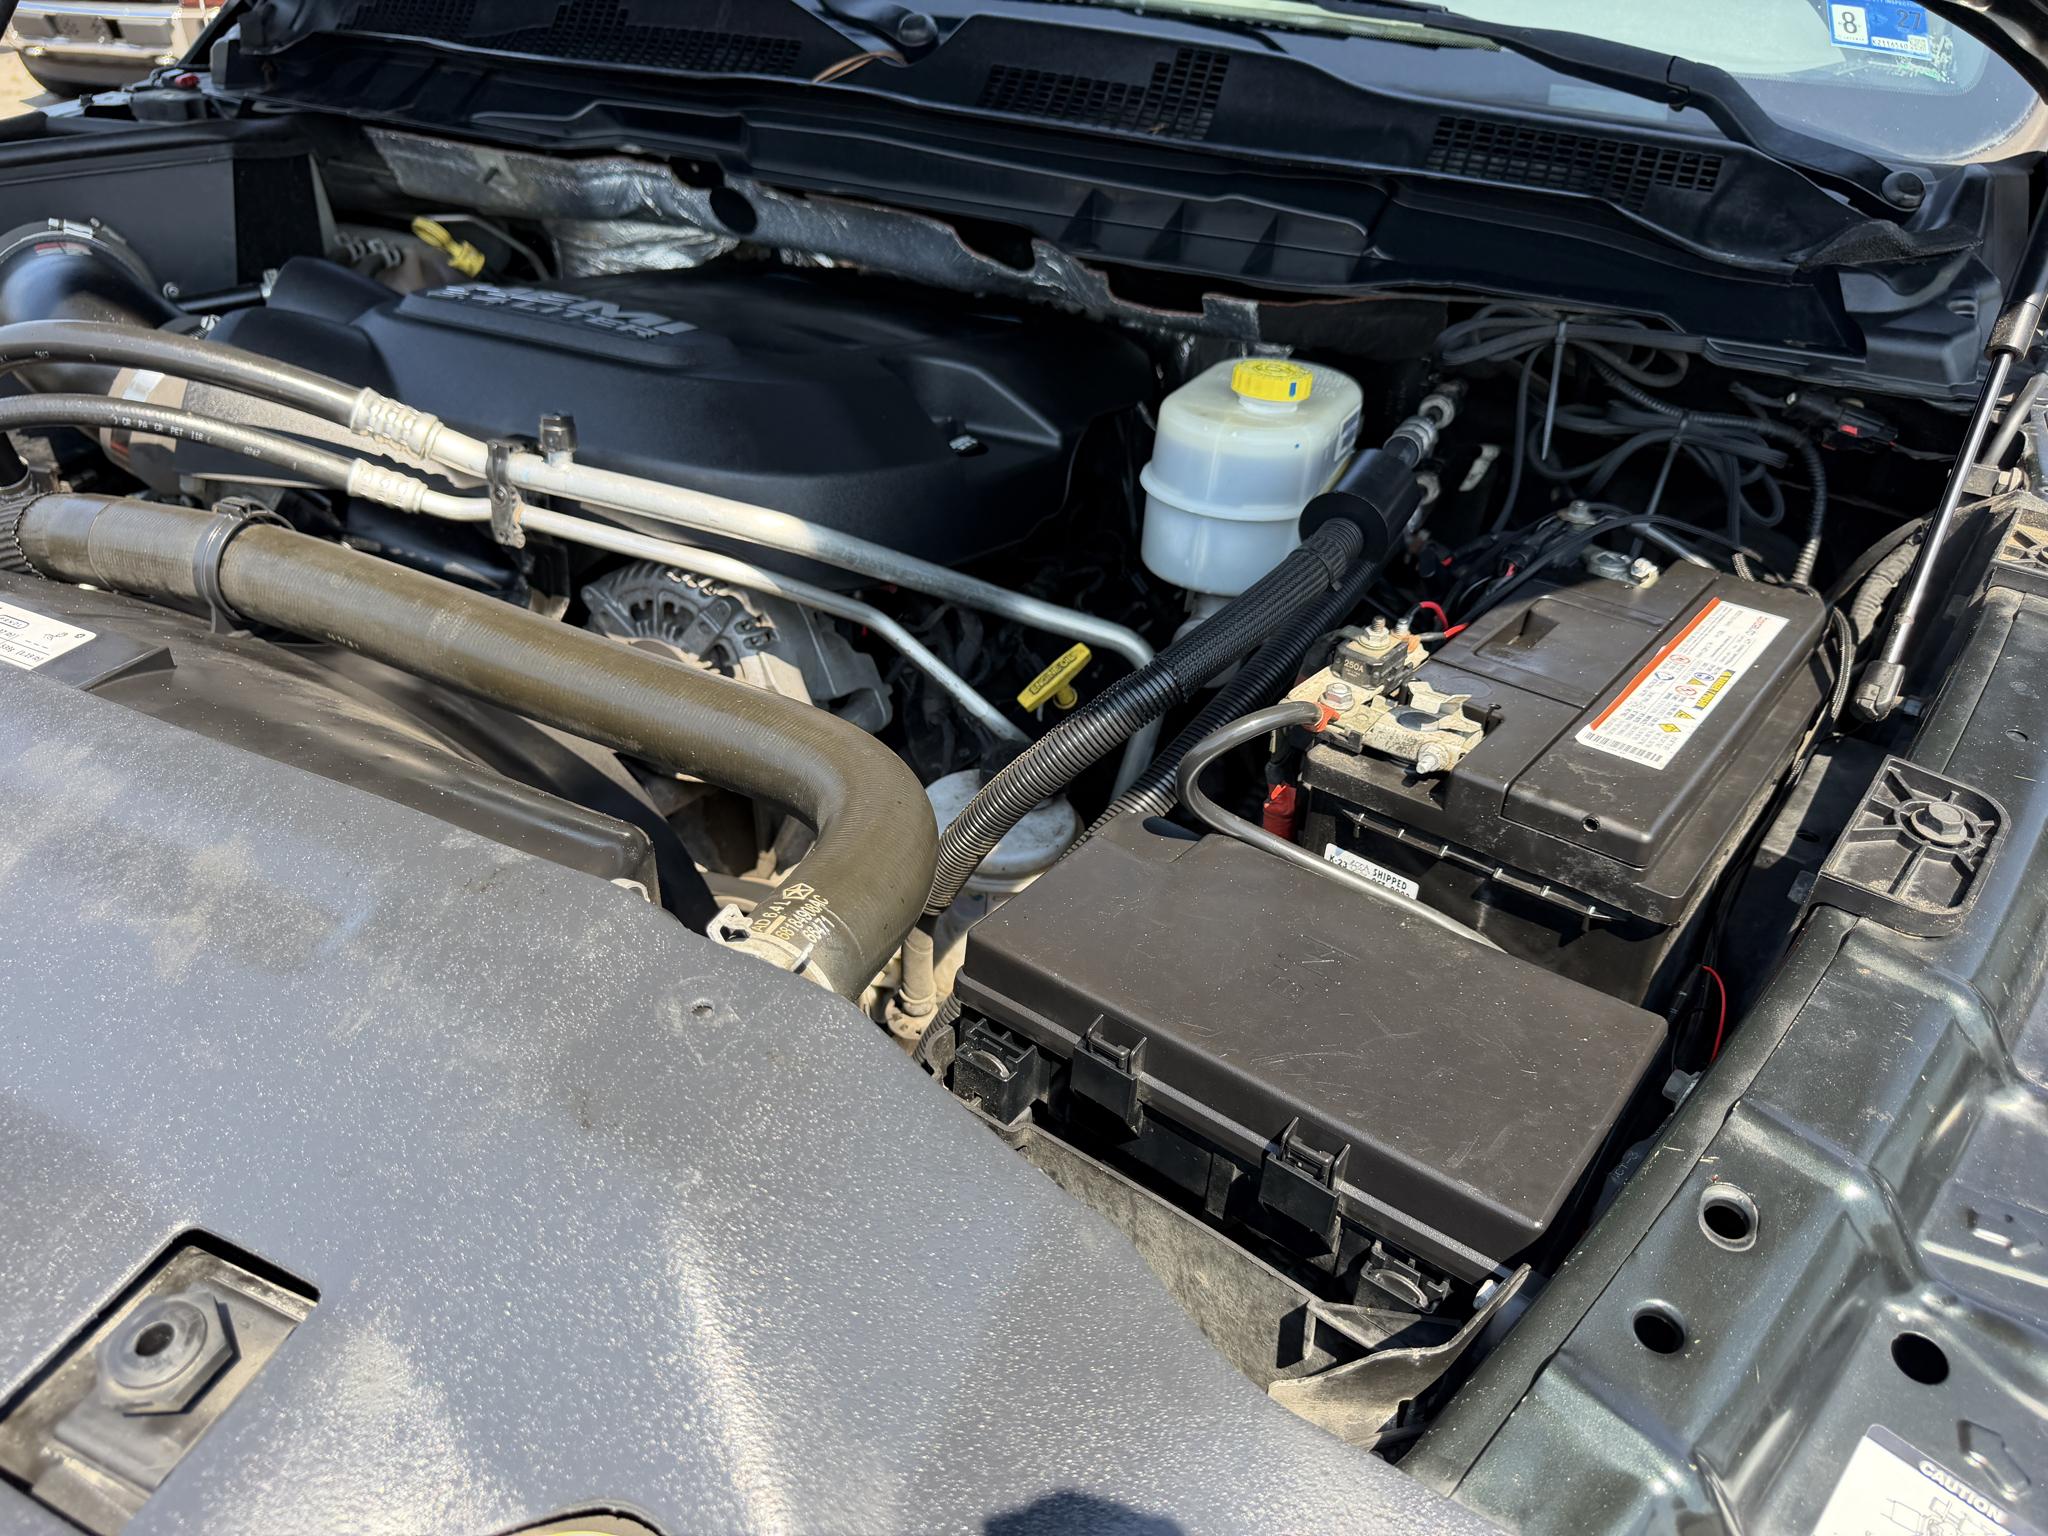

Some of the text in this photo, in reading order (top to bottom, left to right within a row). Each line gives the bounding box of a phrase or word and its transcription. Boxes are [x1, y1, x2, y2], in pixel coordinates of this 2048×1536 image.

[1842, 12, 1857, 33] 8
[1896, 9, 1921, 30] 27
[1029, 653, 1078, 695] ENGINE OIL
[1343, 658, 1365, 673] 250A
[1372, 868, 1408, 890] SHIPPED
[802, 915, 835, 944] 66471
[1919, 1460, 2009, 1525] CAUTION
